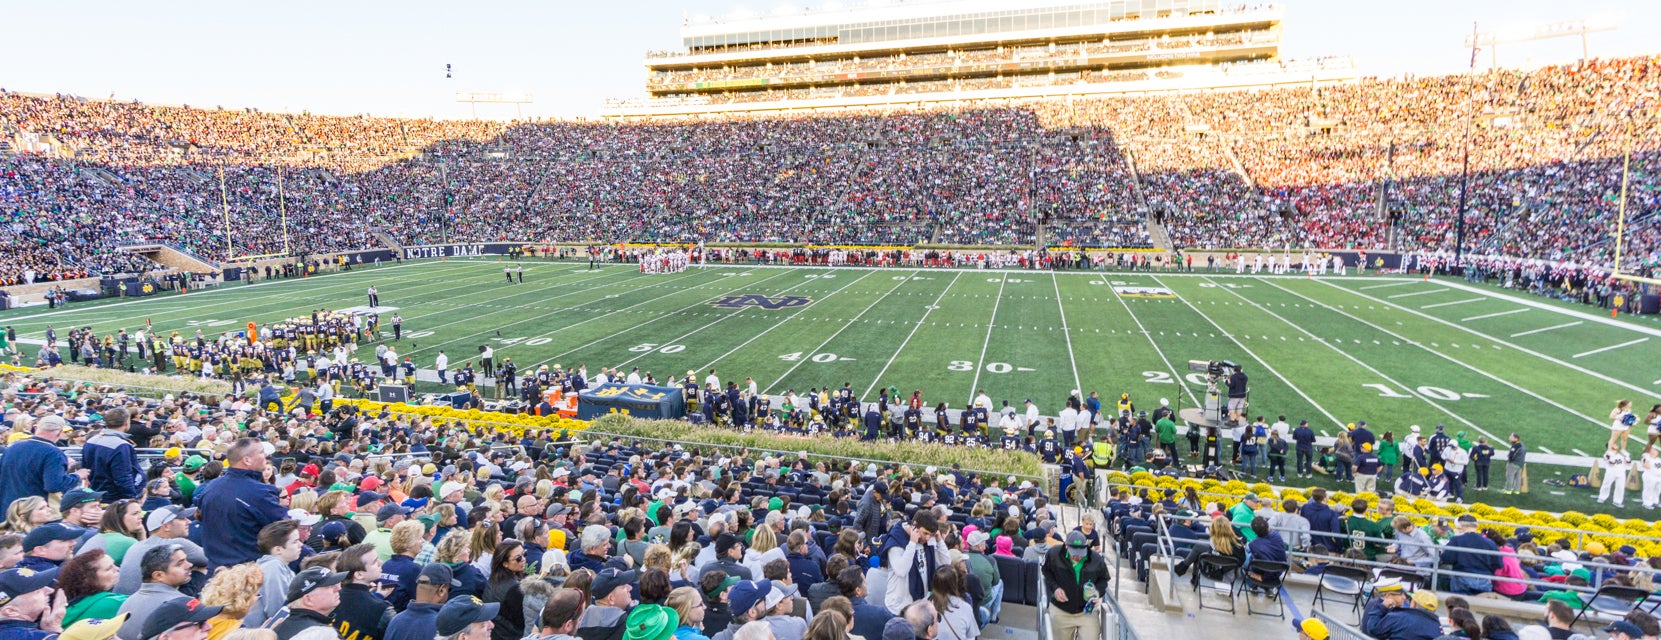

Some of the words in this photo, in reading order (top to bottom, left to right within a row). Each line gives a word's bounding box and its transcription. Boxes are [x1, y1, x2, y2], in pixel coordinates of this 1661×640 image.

[628, 343, 686, 354] 50
[778, 351, 838, 363] 40
[947, 360, 1013, 374] 30
[1362, 383, 1461, 401] 10
[967, 416, 976, 424] 97
[918, 431, 929, 441] 94
[944, 434, 954, 444] 92
[966, 437, 976, 447] 25
[1005, 439, 1016, 450] 54
[1045, 441, 1054, 452] 91
[1064, 449, 1075, 460] 95
